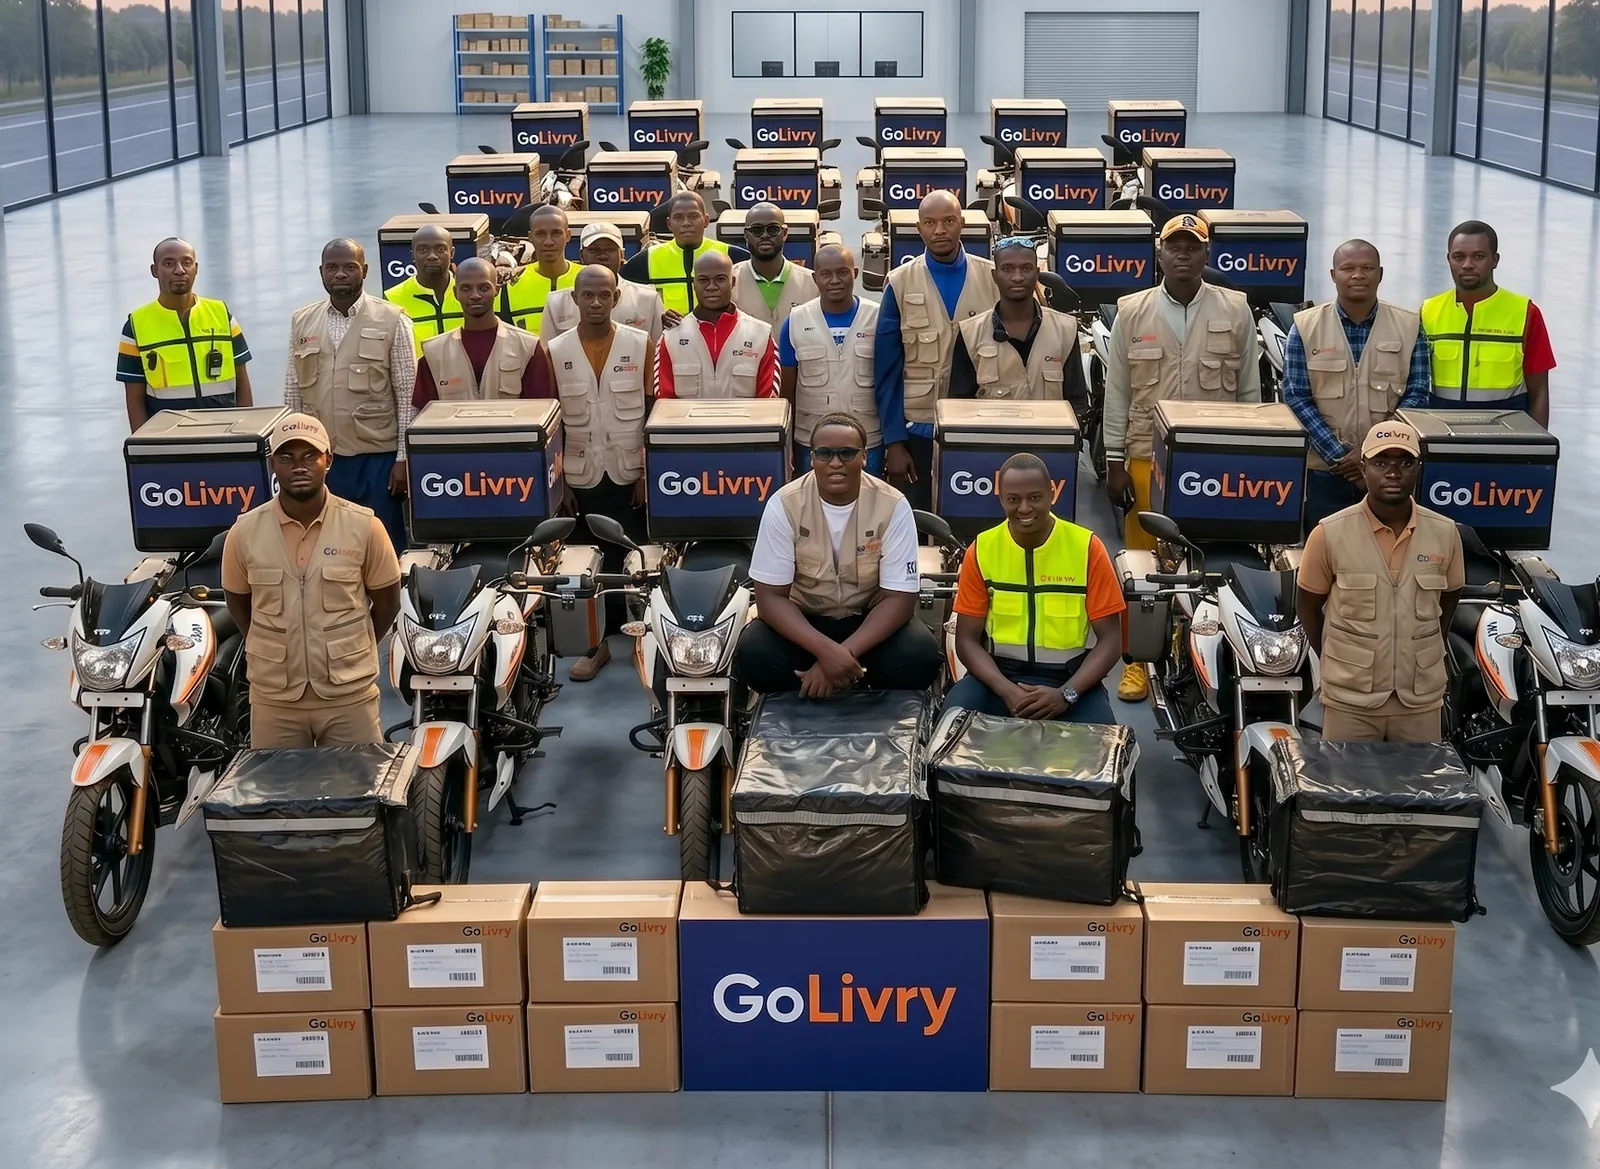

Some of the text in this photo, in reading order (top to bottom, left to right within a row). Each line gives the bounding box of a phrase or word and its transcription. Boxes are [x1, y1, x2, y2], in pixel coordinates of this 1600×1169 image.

[517, 130, 578, 148] GoLivry
[633, 128, 693, 147] GoLivry
[756, 127, 817, 146] GoLivry
[881, 126, 941, 146] GoLivry
[1000, 127, 1062, 146] GoLivry
[1119, 128, 1181, 147] GoLivry
[454, 190, 524, 210] GoLivry
[593, 187, 664, 208] GoLivry
[741, 186, 812, 206] GoLivry
[1028, 183, 1099, 204] GoLivry
[1158, 183, 1229, 204] GoLivry
[1065, 254, 1147, 279] GoLivry
[1217, 252, 1299, 277] GoLivry
[420, 471, 534, 504] GoLivry
[658, 469, 773, 502] GoLivry
[1178, 471, 1293, 506] GoLivry
[139, 480, 256, 513] GoLivry
[1429, 480, 1543, 515] GoLivry
[462, 925, 512, 939] GoLivry
[619, 922, 667, 935] GoLivry
[1087, 921, 1136, 935] GoLivry
[1242, 925, 1291, 939] GoLivry
[309, 932, 358, 946] GoLivry
[1398, 934, 1447, 948] GoLivry
[713, 973, 957, 1036] GoLivry
[309, 1018, 356, 1031] GoLivry
[466, 1011, 515, 1025] GoLivry
[619, 1009, 666, 1023] GoLivry
[1086, 1010, 1135, 1024] GoLivry
[1242, 1012, 1291, 1025] GoLivry
[1396, 1016, 1444, 1030] GoLivry
